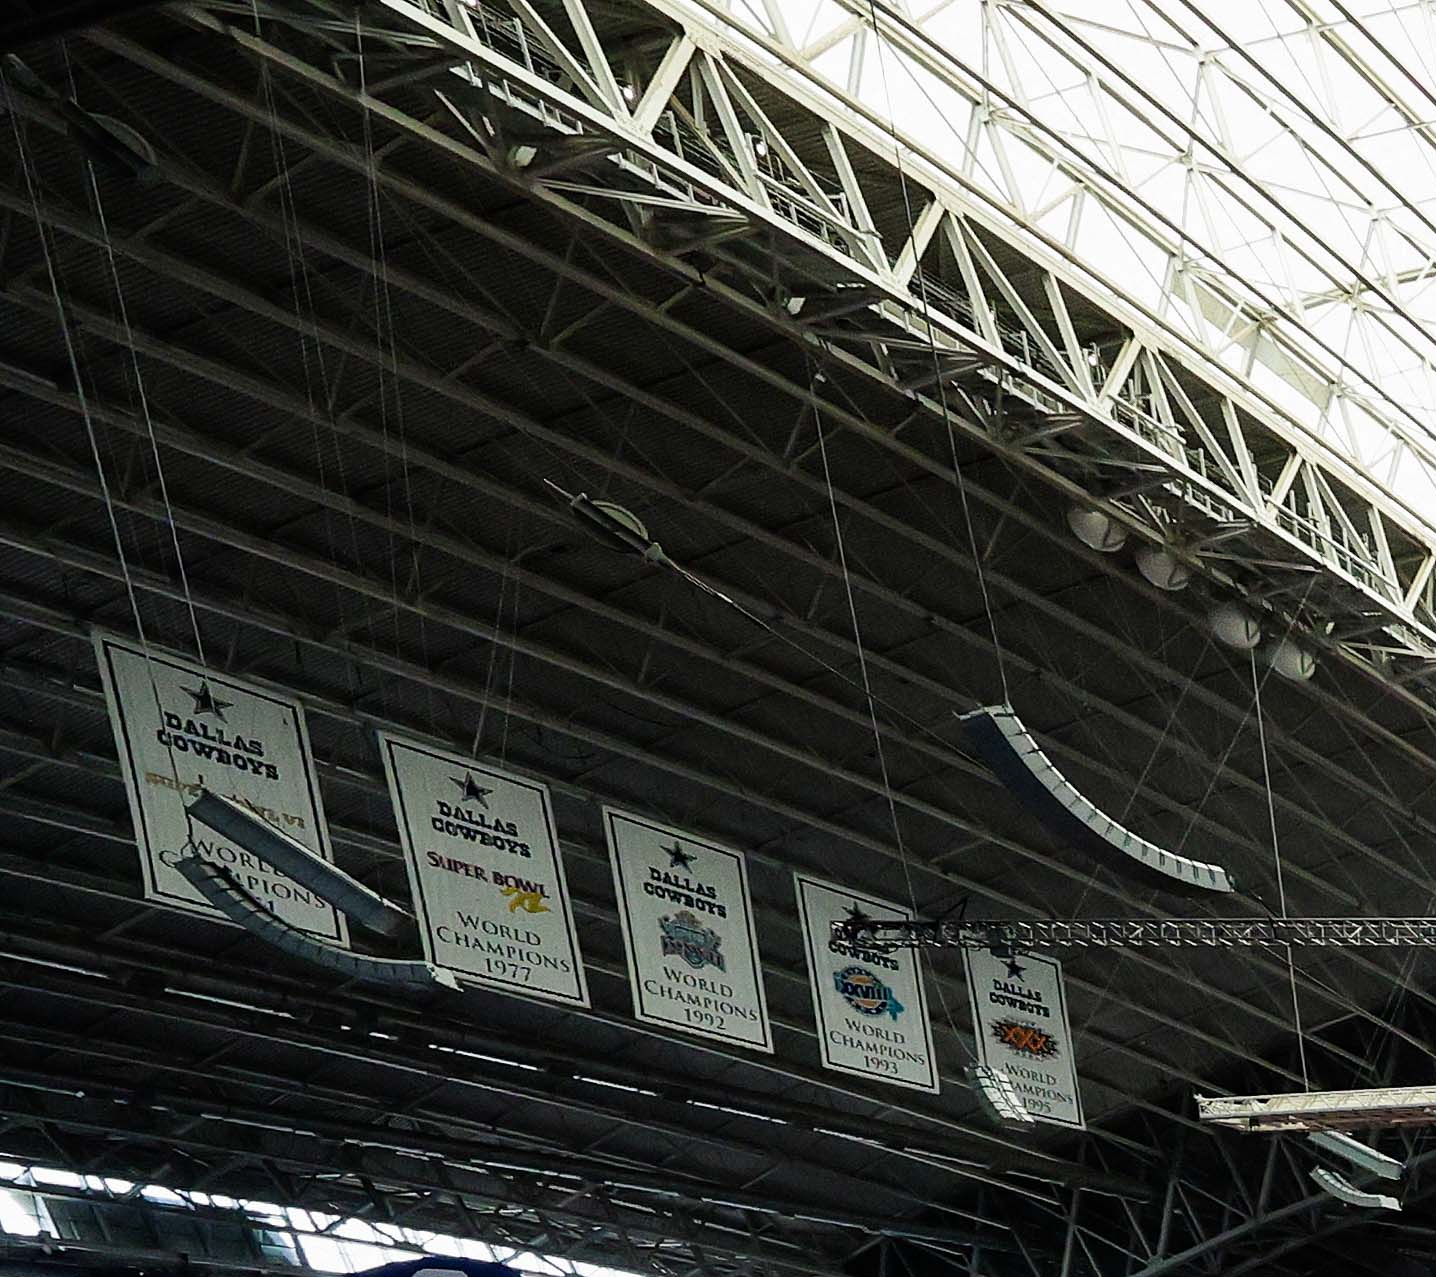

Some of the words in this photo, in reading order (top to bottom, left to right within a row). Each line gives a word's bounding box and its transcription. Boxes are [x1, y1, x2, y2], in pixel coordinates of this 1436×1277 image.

[163, 710, 265, 758] DALLAS
[156, 728, 280, 781] COWBOYS
[436, 800, 519, 837] DALLAS
[431, 817, 532, 858] COWBOYS
[426, 850, 489, 883] SUPER
[491, 871, 550, 899] BOWL
[648, 866, 718, 900] DALLAS
[643, 882, 727, 919] COWBOYS
[456, 911, 541, 946] WORLD
[436, 925, 571, 973] CHAMPIONS
[486, 957, 532, 982] 1977
[663, 966, 734, 998] WORLD
[644, 979, 759, 1022] CHAMPIONS
[989, 992, 1050, 1018] COWBOYS
[992, 978, 1042, 1003] DALLAS
[684, 1008, 726, 1031] 1992
[844, 1018, 905, 1044] WORLD
[829, 1030, 926, 1066] CHAMPIONS
[863, 1055, 899, 1075] 1993
[1004, 1062, 1057, 1086] WORLD
[1009, 1080, 1073, 1105] AMPIONS
